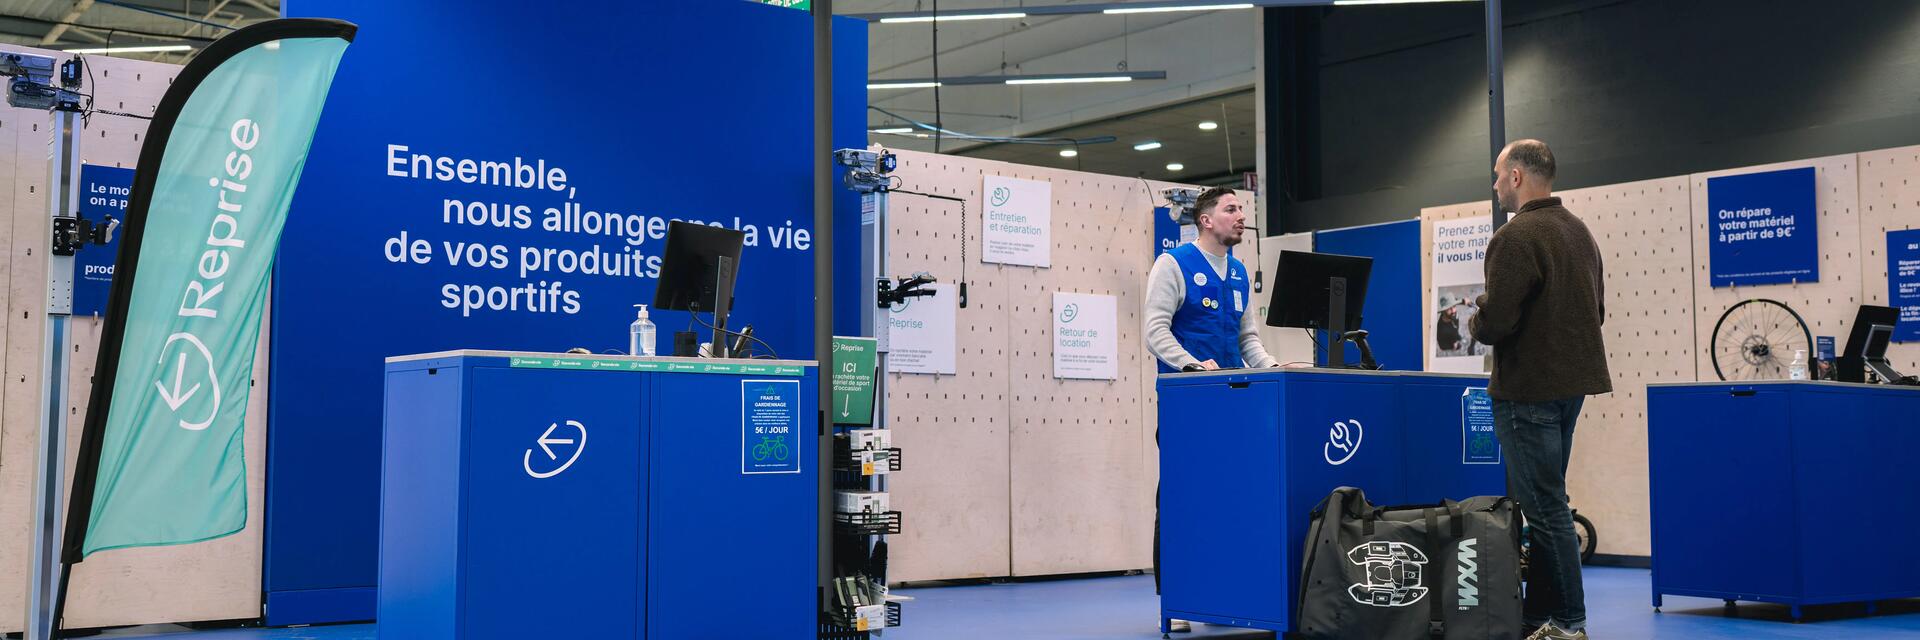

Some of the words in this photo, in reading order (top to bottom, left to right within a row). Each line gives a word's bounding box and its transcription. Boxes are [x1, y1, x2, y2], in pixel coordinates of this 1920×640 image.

[386, 143, 576, 199] Ensemble,
[90, 182, 107, 194] Le
[89, 196, 107, 206] on
[109, 198, 117, 207] a
[178, 118, 260, 319] Reprise
[989, 210, 1027, 223] Entretien
[1719, 209, 1734, 219] On
[1736, 207, 1772, 219] répare
[443, 198, 532, 230] nous
[542, 201, 724, 246] allonge
[768, 220, 811, 251] vie
[989, 223, 998, 232] et
[1000, 223, 1042, 235] réparation
[1719, 220, 1747, 231] votre
[1749, 215, 1794, 228] matériel
[1438, 225, 1475, 238] Prenez
[1719, 232, 1726, 242] à
[1728, 230, 1758, 244] partir
[1760, 229, 1774, 239] de
[1162, 238, 1175, 249] On
[1438, 239, 1465, 250] votre
[384, 230, 432, 264] de
[443, 241, 509, 269] vos
[520, 244, 663, 279] produits
[1437, 252, 1444, 263] il
[1446, 252, 1473, 262] vous
[441, 280, 581, 317] sportifs
[889, 317, 923, 330] Reprise
[1060, 327, 1086, 337] Retour
[1087, 328, 1098, 338] de
[840, 343, 864, 353] Reprise
[1059, 338, 1091, 348] location
[842, 362, 857, 373] ICI
[768, 426, 789, 434] JOUR
